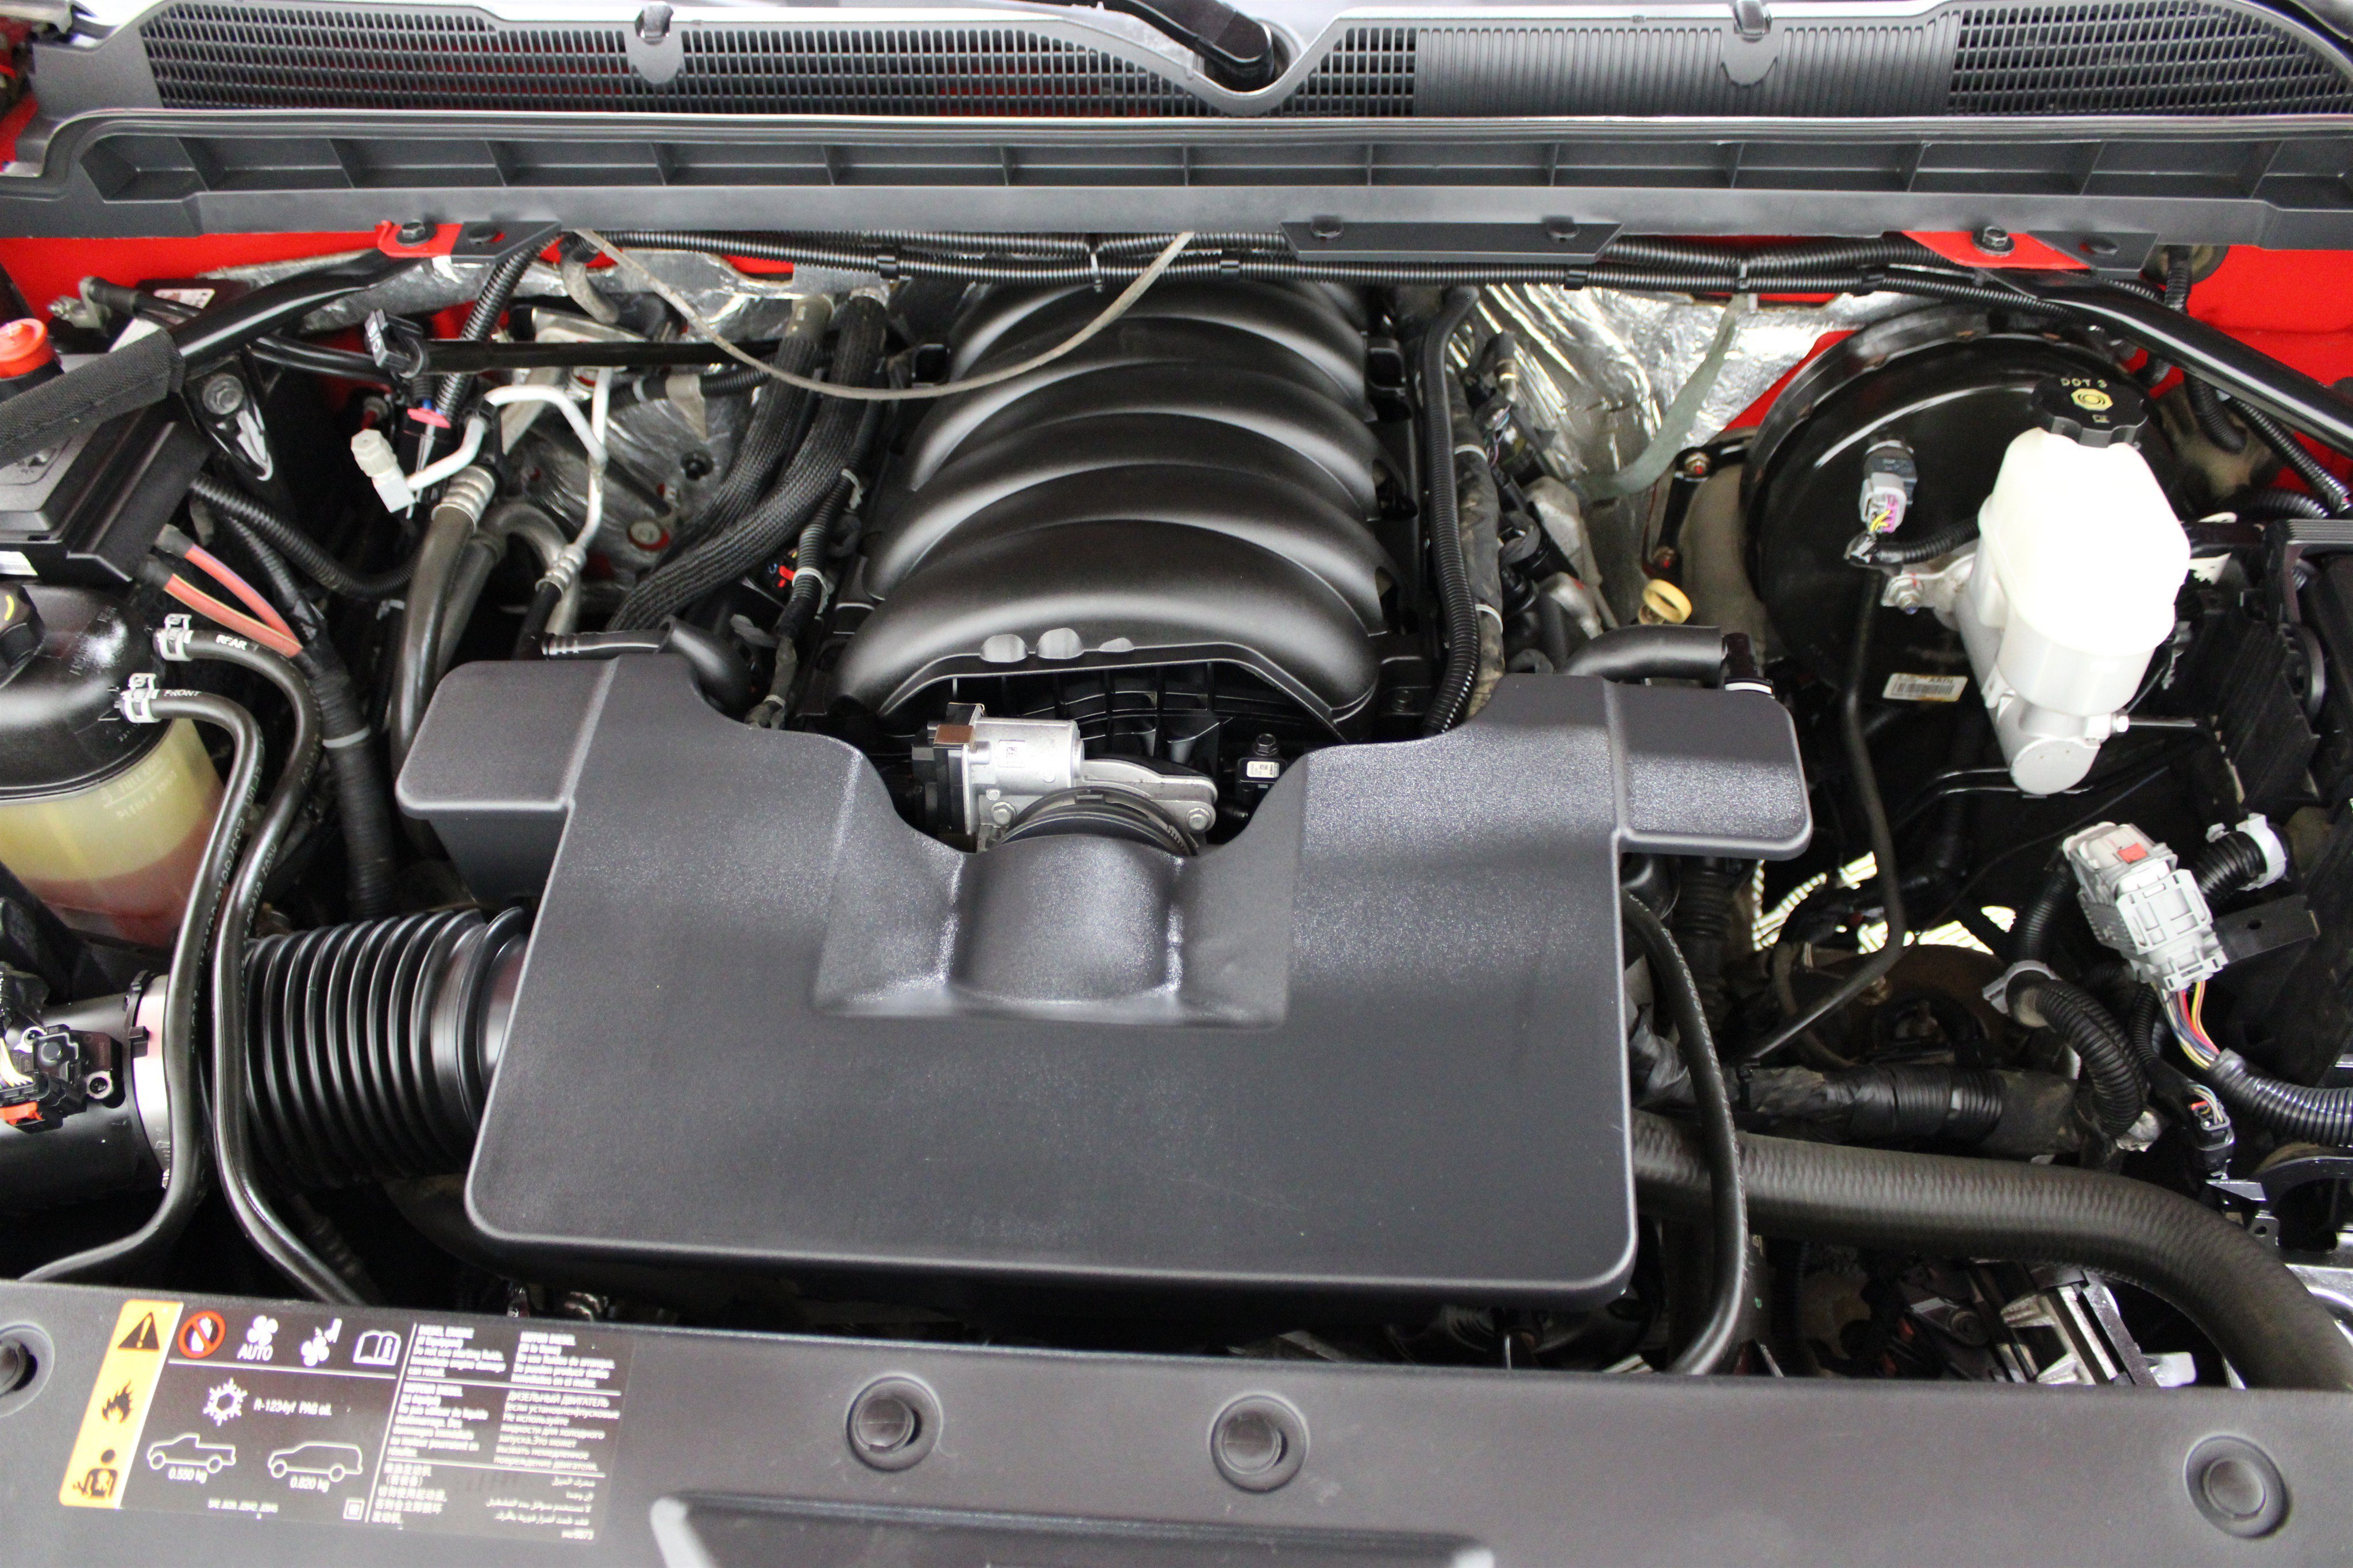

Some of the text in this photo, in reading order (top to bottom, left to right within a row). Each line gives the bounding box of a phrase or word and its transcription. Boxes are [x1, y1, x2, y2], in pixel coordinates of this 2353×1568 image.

[2060, 377, 2091, 387] DOT
[215, 634, 248, 650] REAR
[237, 1343, 273, 1361] AUTO
[253, 1397, 332, 1416] R-1234yf PAG oil.
[507, 1389, 610, 1408] ДИЗЕЛЬНЫЙ ДВИГАТЕЛЬ
[503, 1411, 570, 1427] Не используйте
